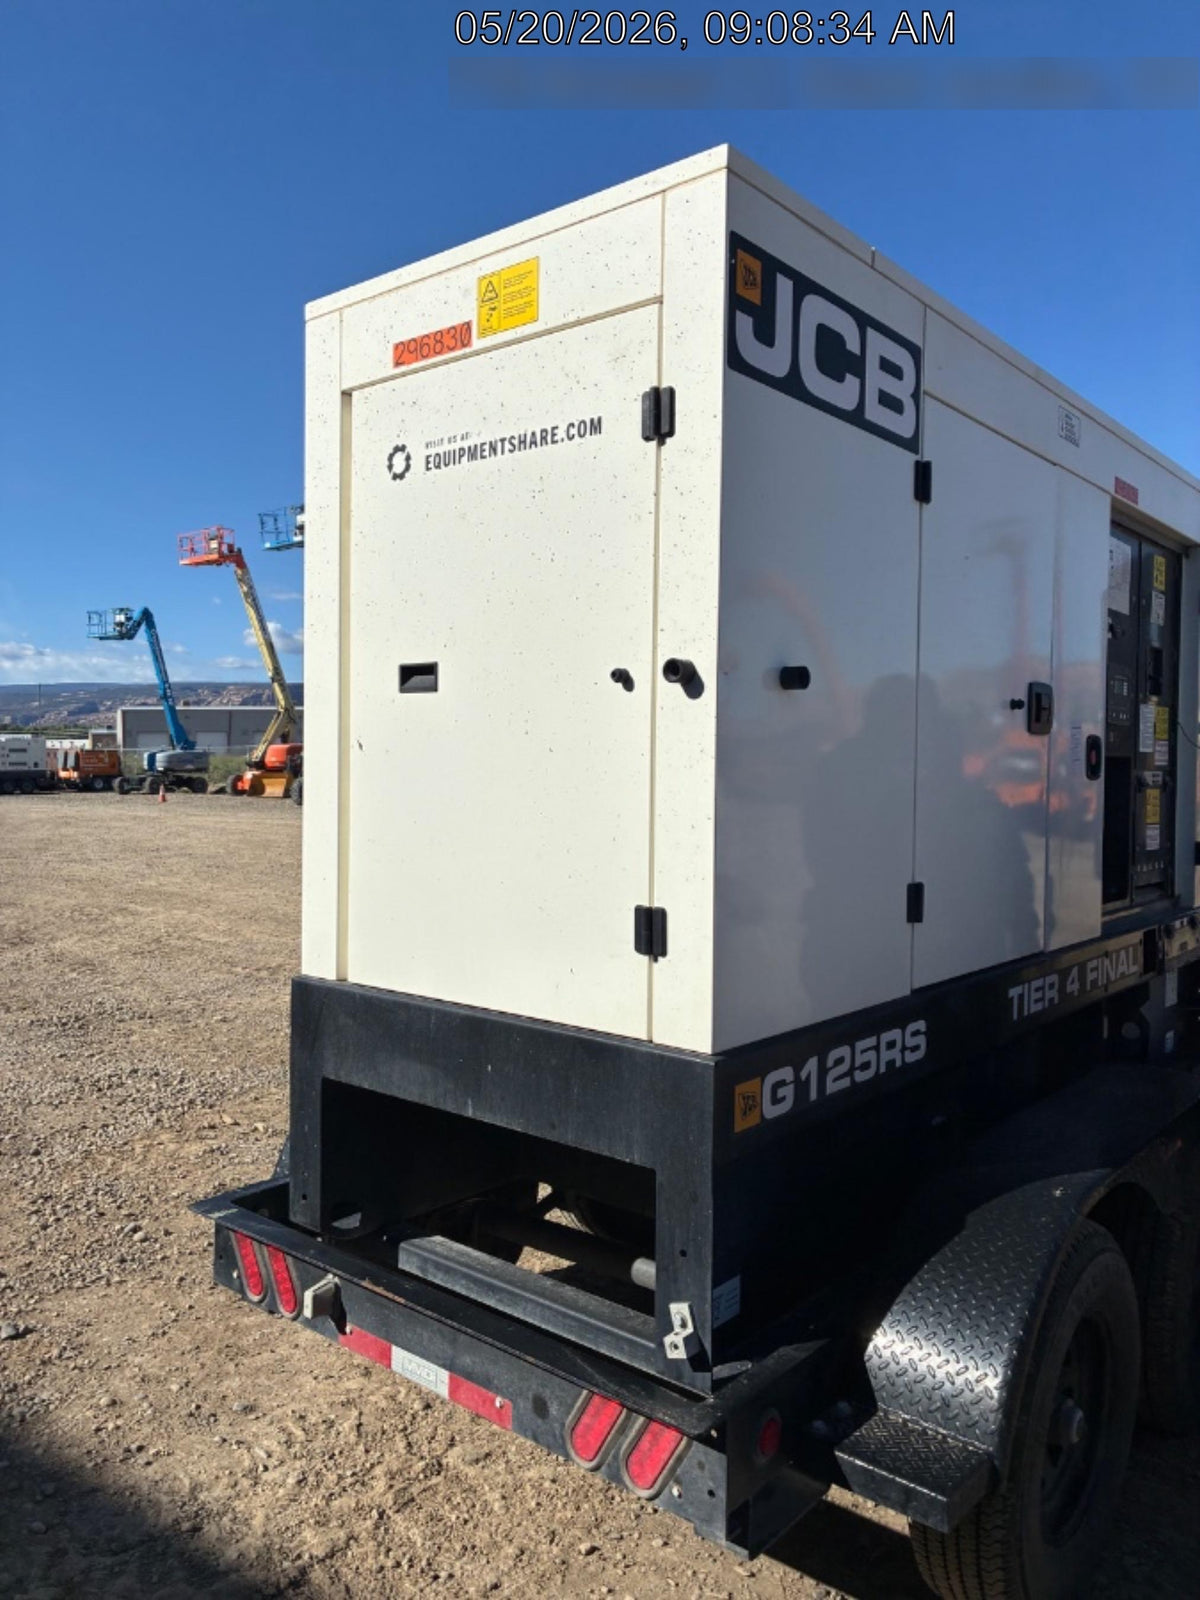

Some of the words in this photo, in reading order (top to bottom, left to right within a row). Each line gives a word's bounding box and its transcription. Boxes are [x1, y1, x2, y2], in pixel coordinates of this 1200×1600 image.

[394, 321, 472, 366] 296830
[736, 272, 917, 439] JCB
[424, 415, 603, 472] EQUIPMENTSHARE.COM
[1008, 974, 1059, 1021] TIER
[1066, 969, 1080, 996] 4
[1085, 947, 1139, 991] FINAL
[762, 1019, 928, 1120] G125RS
